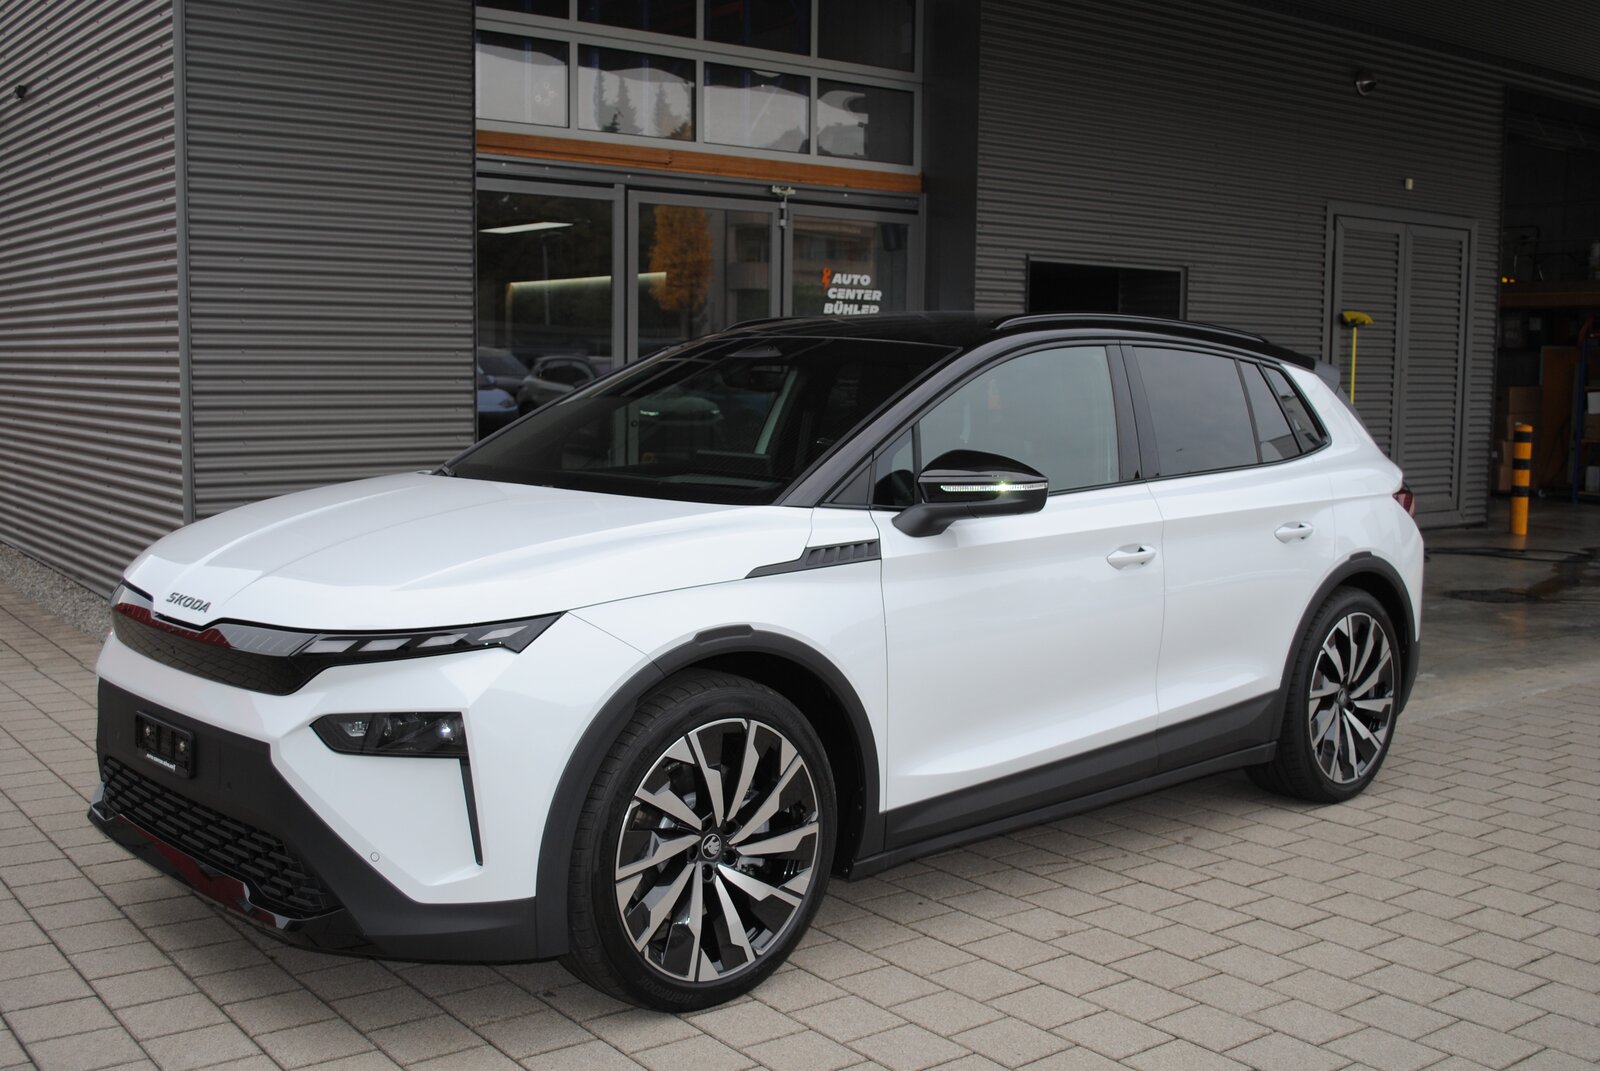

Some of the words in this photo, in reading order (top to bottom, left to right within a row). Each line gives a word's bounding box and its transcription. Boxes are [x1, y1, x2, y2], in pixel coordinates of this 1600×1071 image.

[832, 273, 871, 286] AUTO
[827, 287, 882, 301] CENTER
[823, 301, 880, 315] BÜHLER
